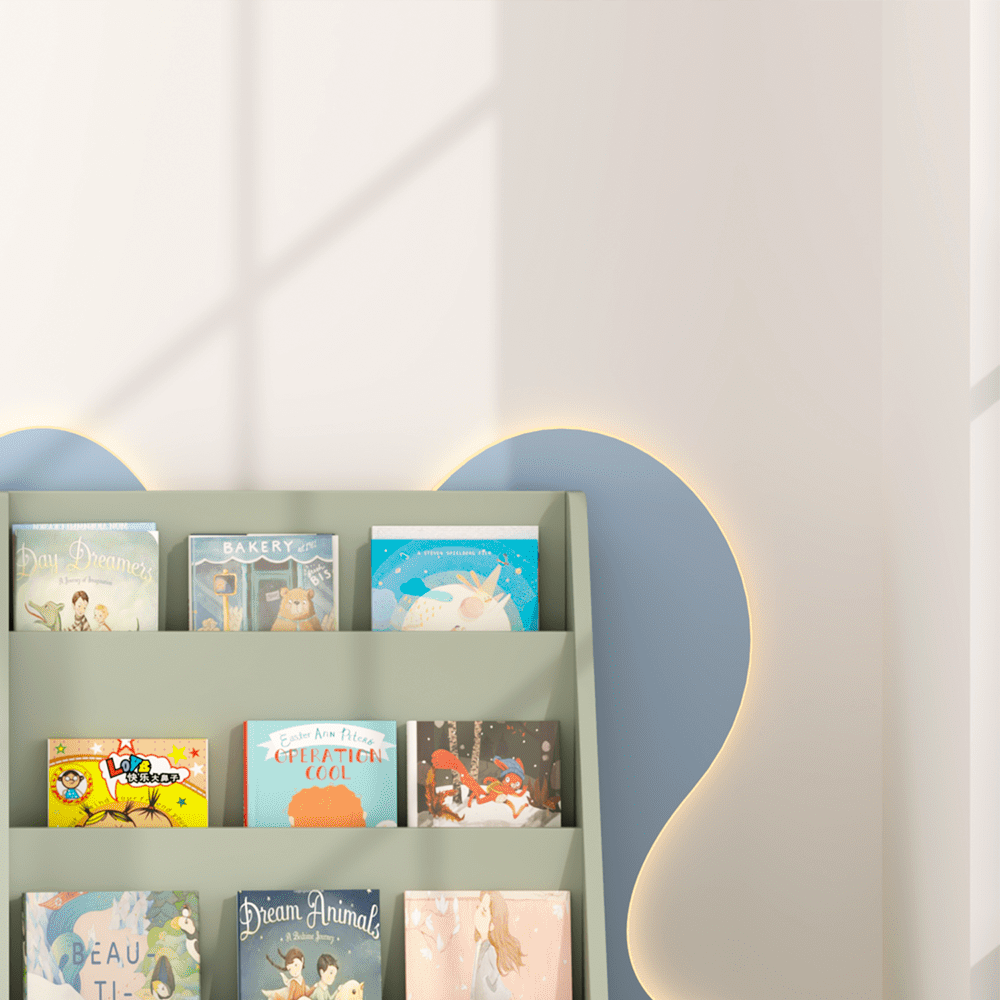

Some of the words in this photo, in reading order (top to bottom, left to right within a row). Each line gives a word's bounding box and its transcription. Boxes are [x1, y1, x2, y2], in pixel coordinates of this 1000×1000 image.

[223, 540, 293, 554] BAKERY
[16, 542, 58, 581] Day
[66, 536, 153, 583] Dreamers
[279, 732, 311, 748] Easter
[274, 748, 383, 764] OPERATION
[305, 765, 351, 781] COOL
[239, 896, 303, 941] Dream
[306, 889, 380, 940] Animals
[72, 941, 156, 965] BEAU-
